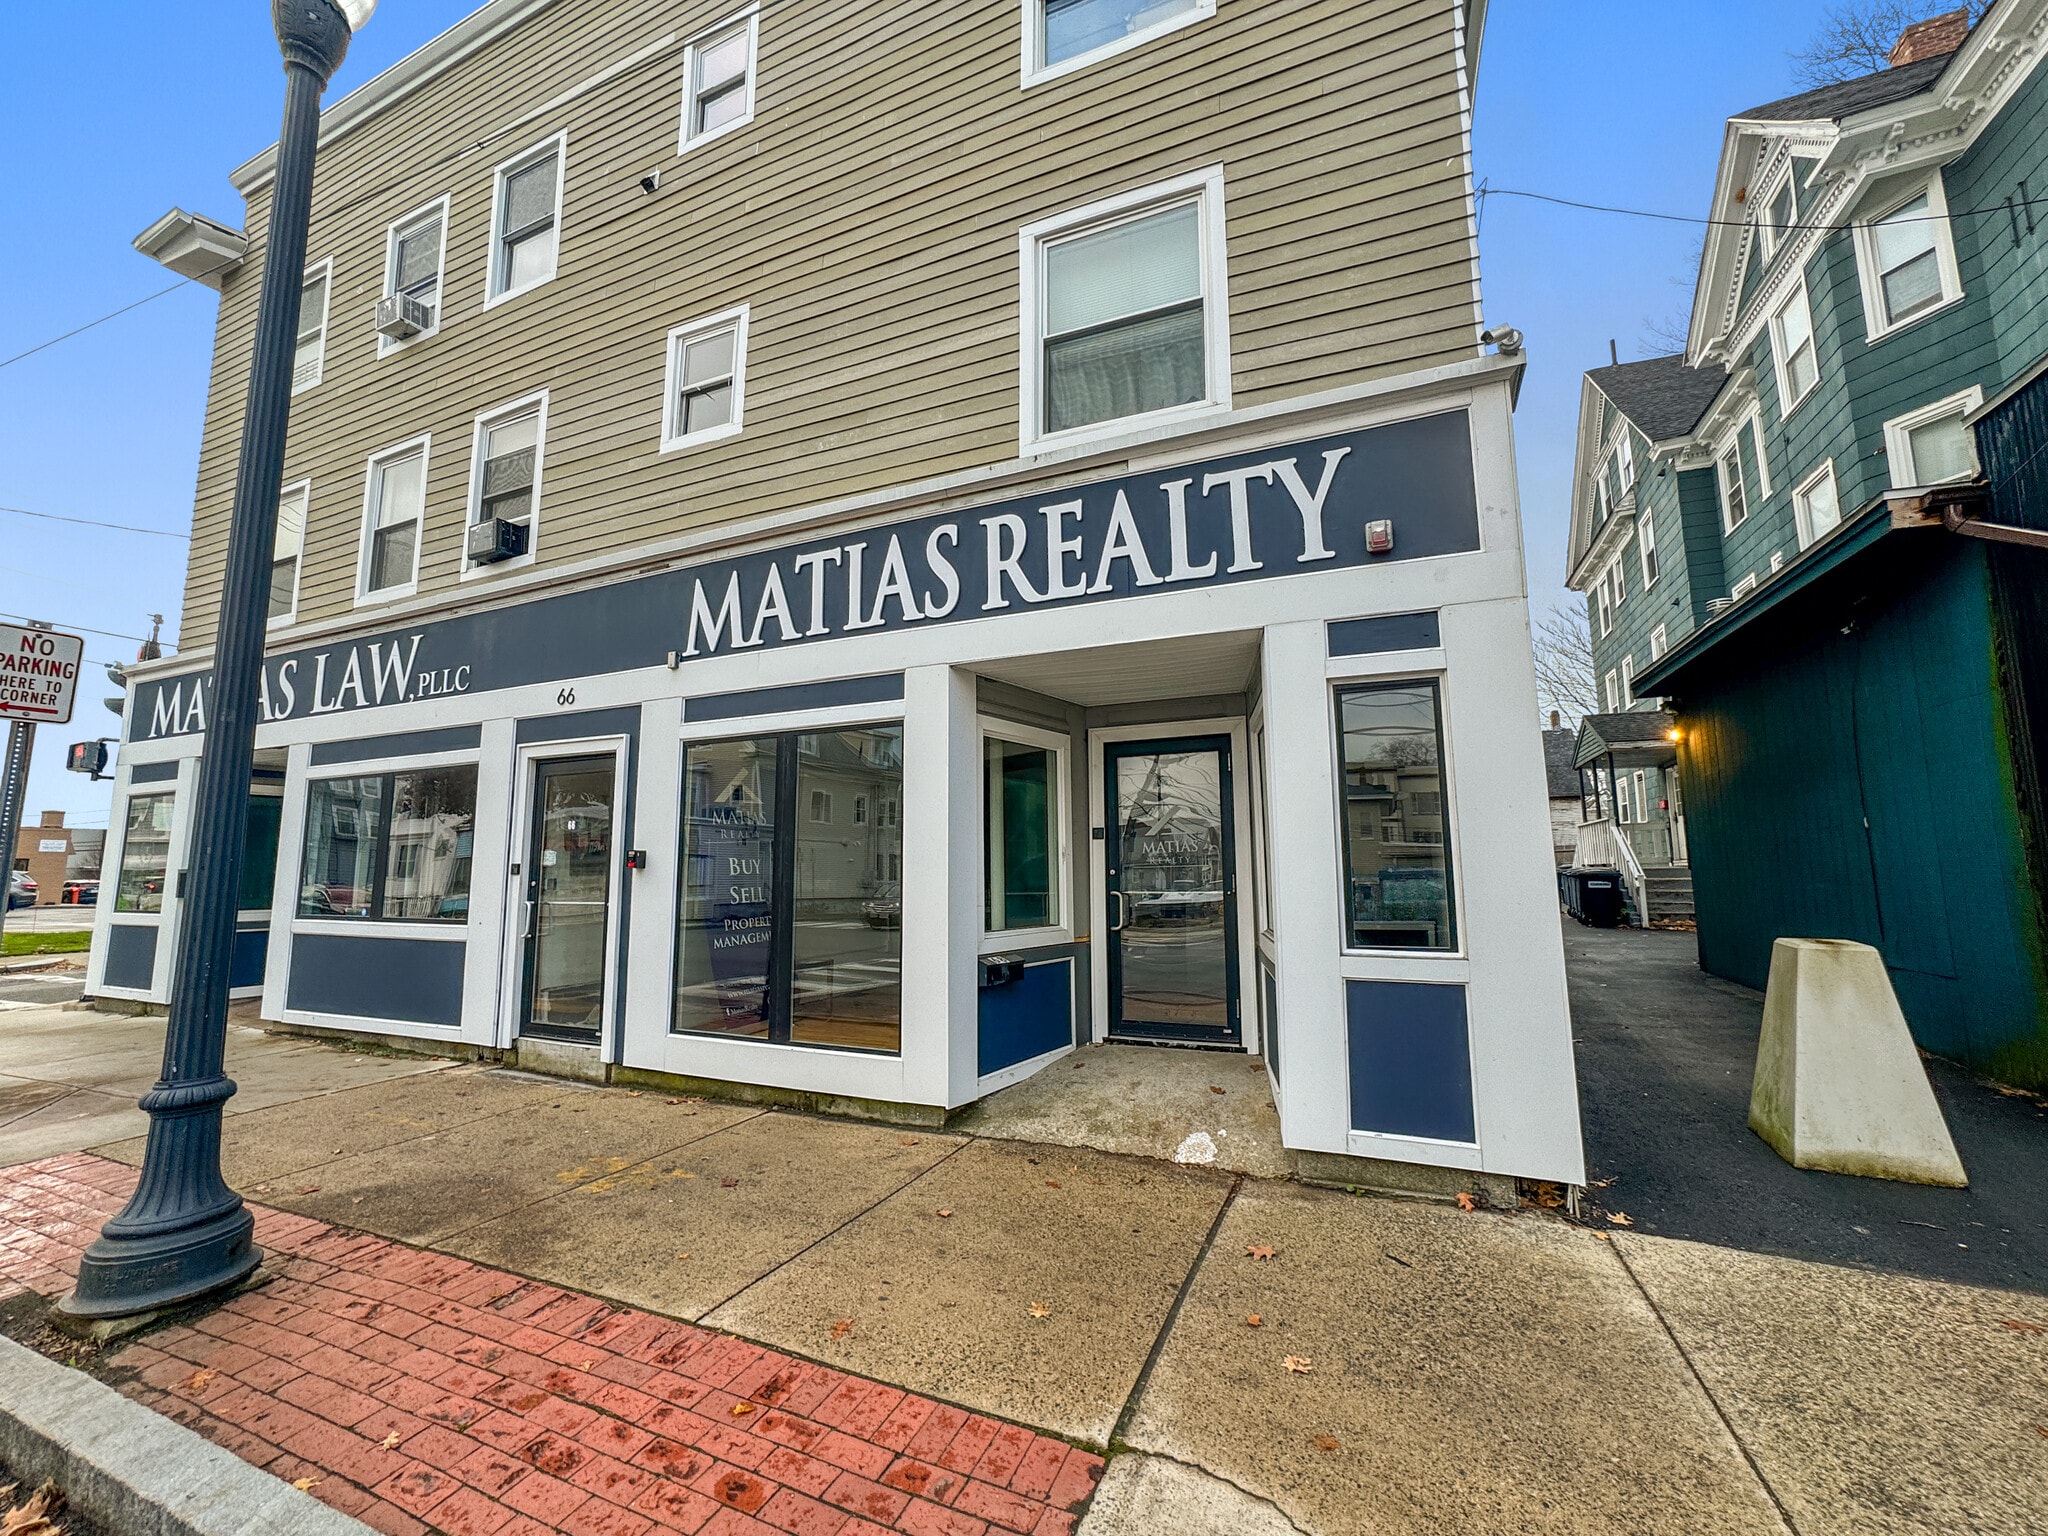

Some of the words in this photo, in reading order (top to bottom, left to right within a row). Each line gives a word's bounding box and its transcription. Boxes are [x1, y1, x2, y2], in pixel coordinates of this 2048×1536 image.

[681, 523, 960, 658] MATIAS
[979, 446, 1353, 612] REALTY
[20, 635, 54, 656] NO
[0, 675, 36, 690] HERE
[46, 680, 62, 693] TO
[0, 688, 57, 706] CORNER
[148, 660, 298, 738] MAAS
[417, 664, 470, 697] PLLC
[557, 687, 574, 705] 66
[567, 820, 576, 830] 66
[712, 810, 767, 825] MATIAS
[1142, 840, 1199, 854] MATIAS
[1148, 856, 1191, 865] REALTY
